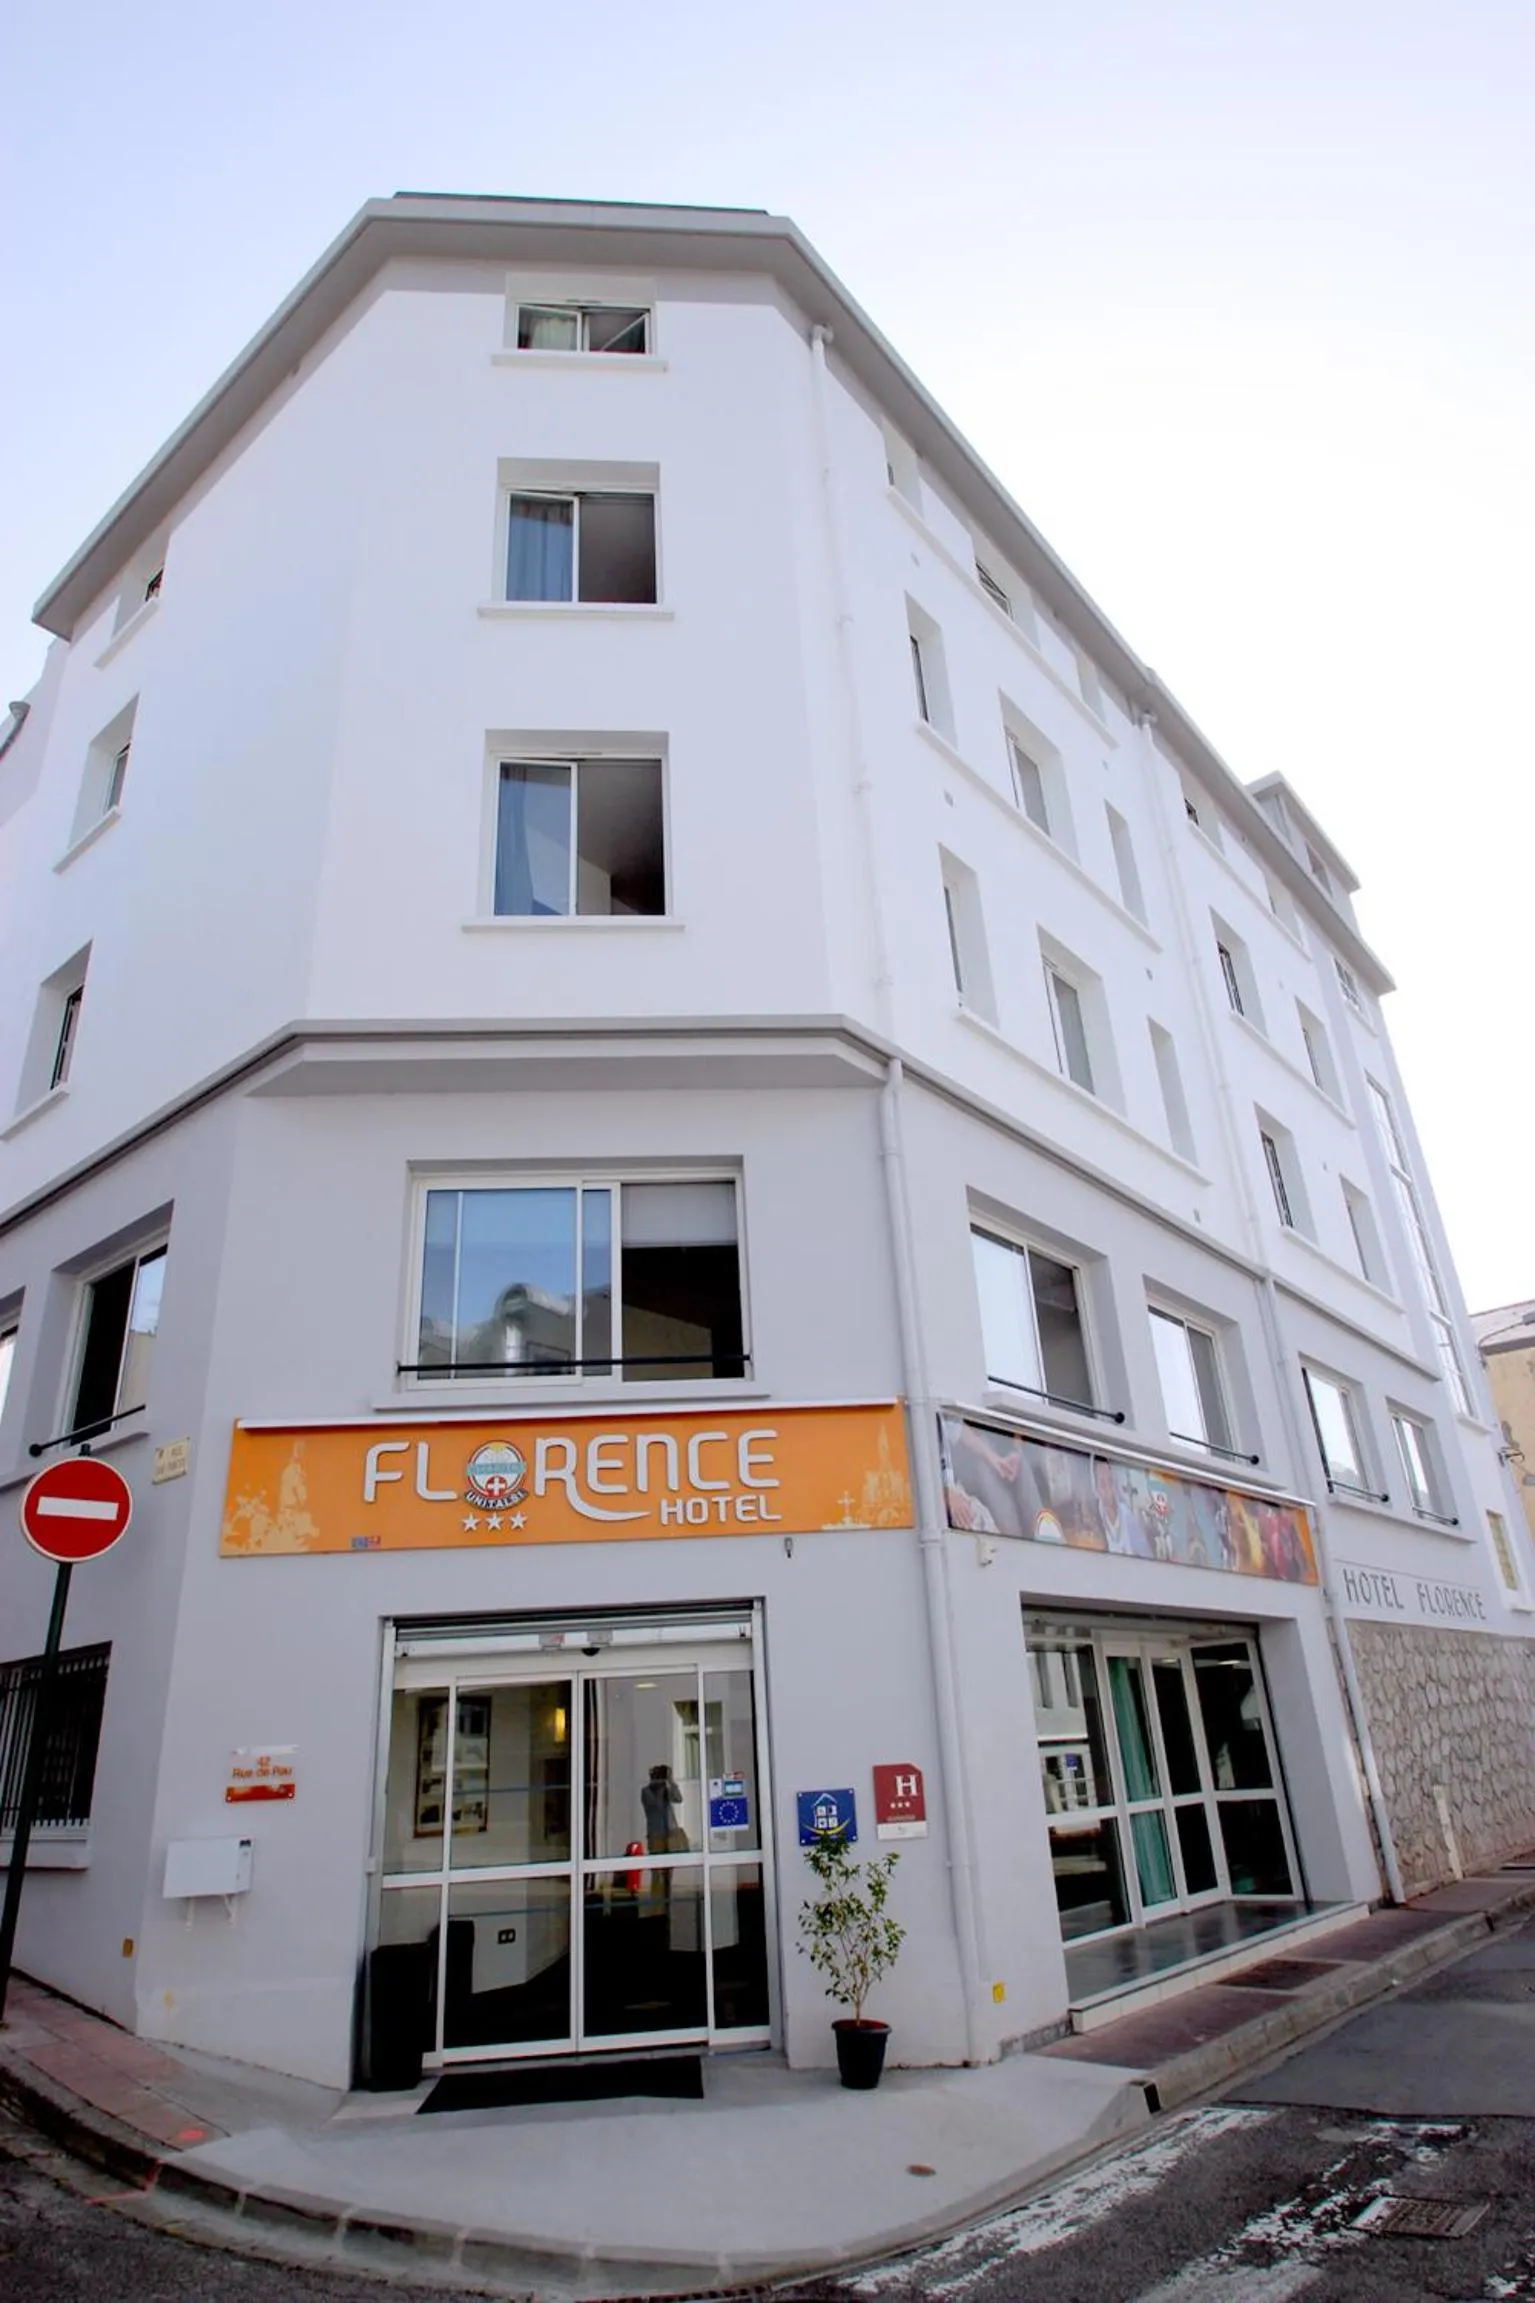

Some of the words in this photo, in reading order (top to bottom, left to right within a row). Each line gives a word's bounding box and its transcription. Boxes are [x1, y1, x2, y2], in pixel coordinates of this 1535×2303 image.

[659, 1494, 783, 1526] HOTEL
[1342, 1568, 1405, 1609] HOTEL
[1416, 1582, 1488, 1621] FLORENCE
[895, 1774, 919, 1797] H
